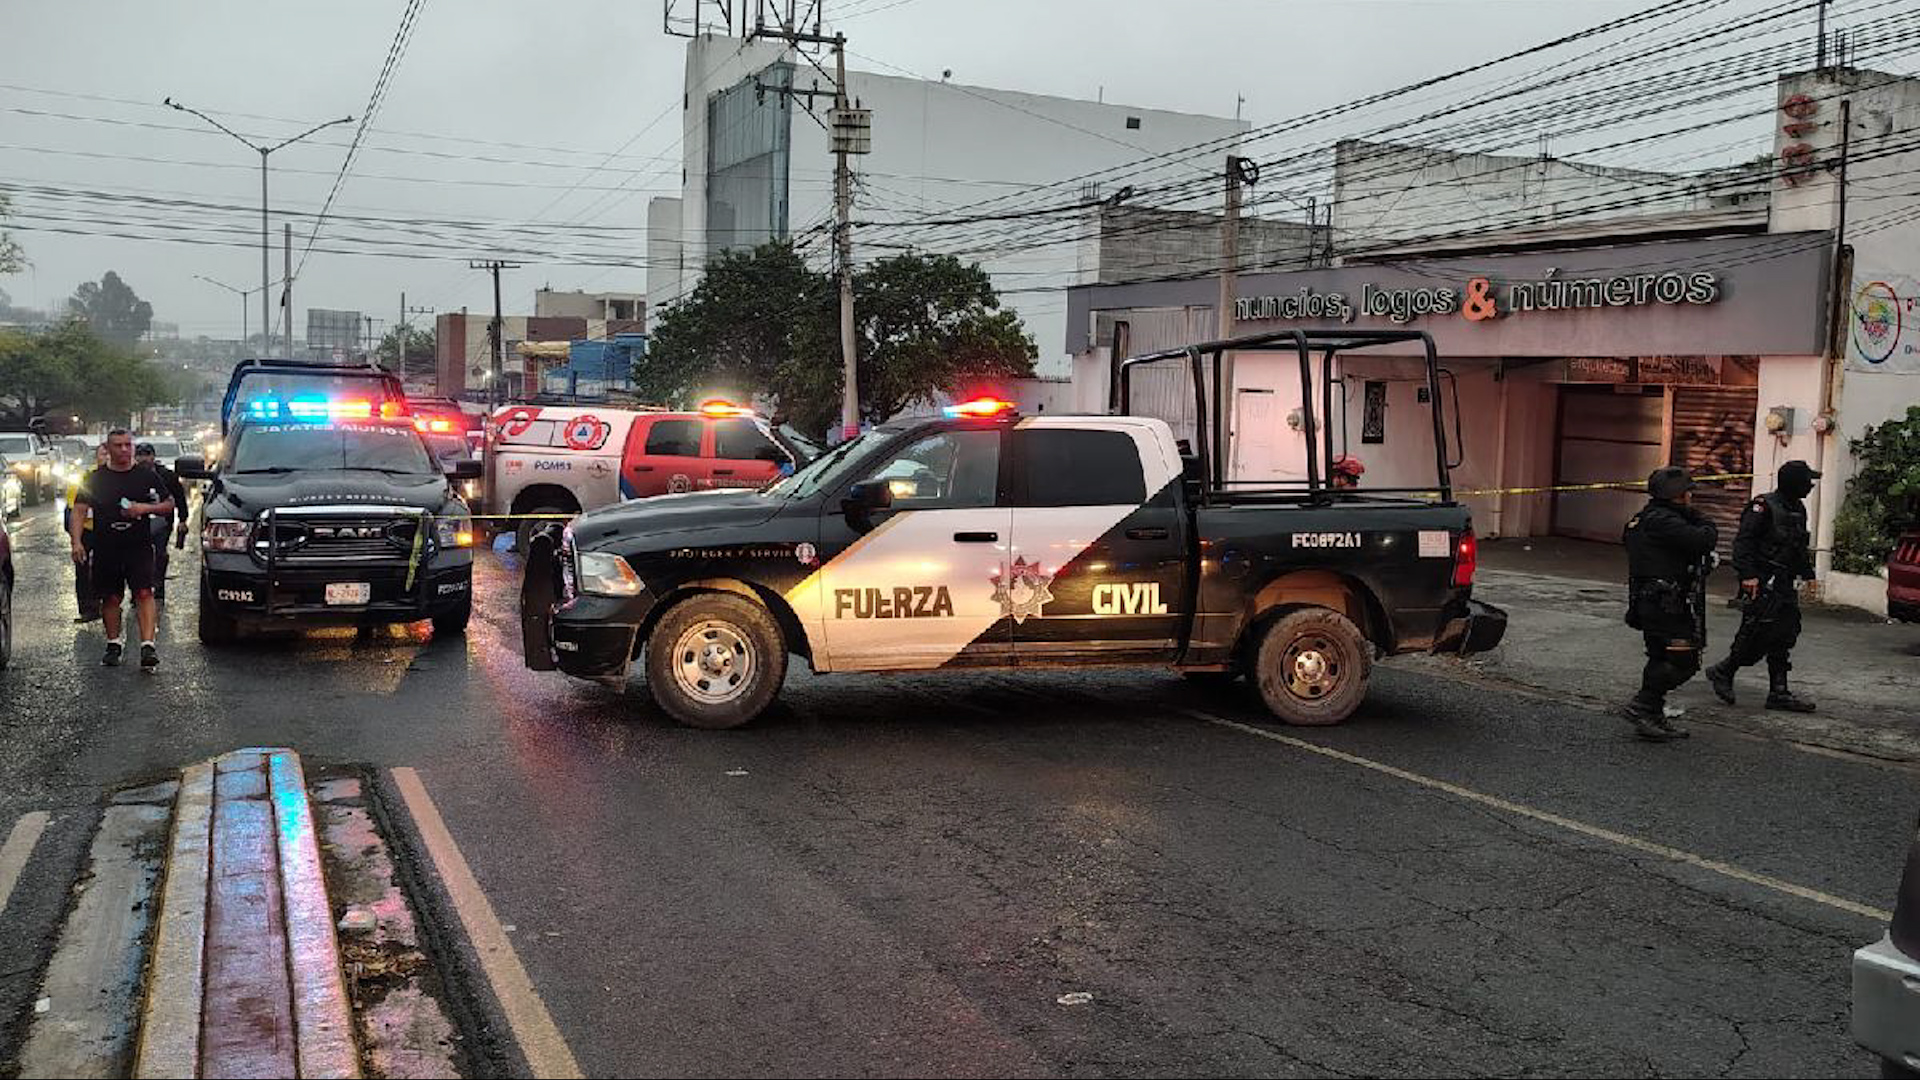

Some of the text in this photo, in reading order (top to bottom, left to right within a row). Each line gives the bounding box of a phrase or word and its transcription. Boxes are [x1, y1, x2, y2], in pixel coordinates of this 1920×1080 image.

[1235, 267, 1716, 323] nuncios, logos & números
[834, 582, 1168, 619] FUERZA CIVIL
